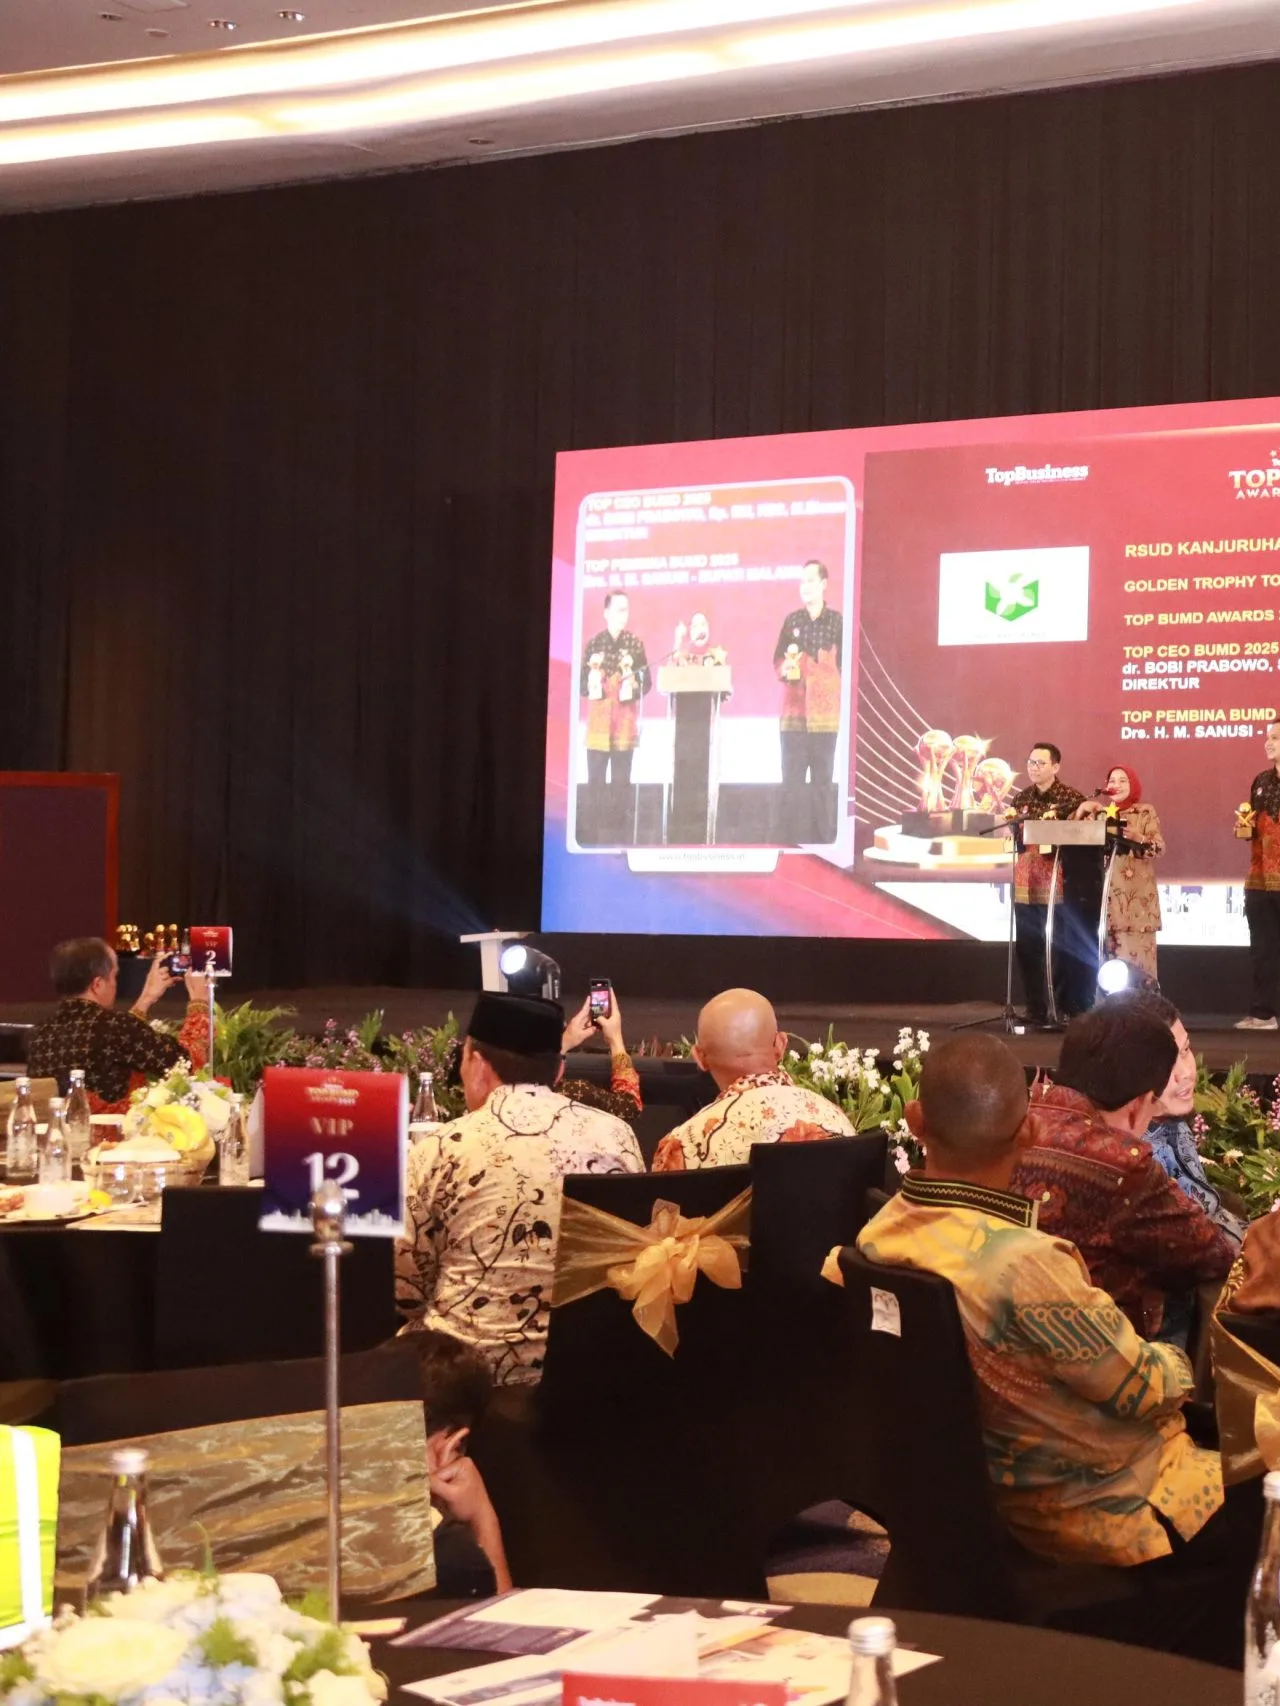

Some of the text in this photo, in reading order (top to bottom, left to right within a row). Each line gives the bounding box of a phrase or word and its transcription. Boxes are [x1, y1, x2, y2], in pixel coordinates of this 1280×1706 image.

[986, 464, 1089, 485] TopBusiness
[1125, 543, 1173, 558] RSUD
[1124, 578, 1188, 592] GOLDEN
[1193, 575, 1256, 590] TROPHY
[1124, 613, 1154, 626] TOP
[1158, 612, 1204, 625] BUMD
[1206, 609, 1275, 624] AWARDS
[1123, 641, 1280, 659] TOP CEO BUMD 2025
[1122, 662, 1141, 675] dr.
[1145, 660, 1183, 674] BOBI
[1187, 658, 1273, 673] PRABOWO,
[1122, 676, 1200, 691] DIREKTUR
[1122, 710, 1152, 723] TOP
[1156, 708, 1226, 722] PEMBINA
[1230, 707, 1277, 721] BUMD
[1121, 726, 1150, 740] Drs.
[1154, 726, 1169, 739] H.
[1173, 725, 1191, 738] M.
[1195, 724, 1254, 738] SANUSI
[205, 950, 216, 965] 2
[309, 1117, 354, 1136] VIP
[303, 1152, 360, 1199] 12
